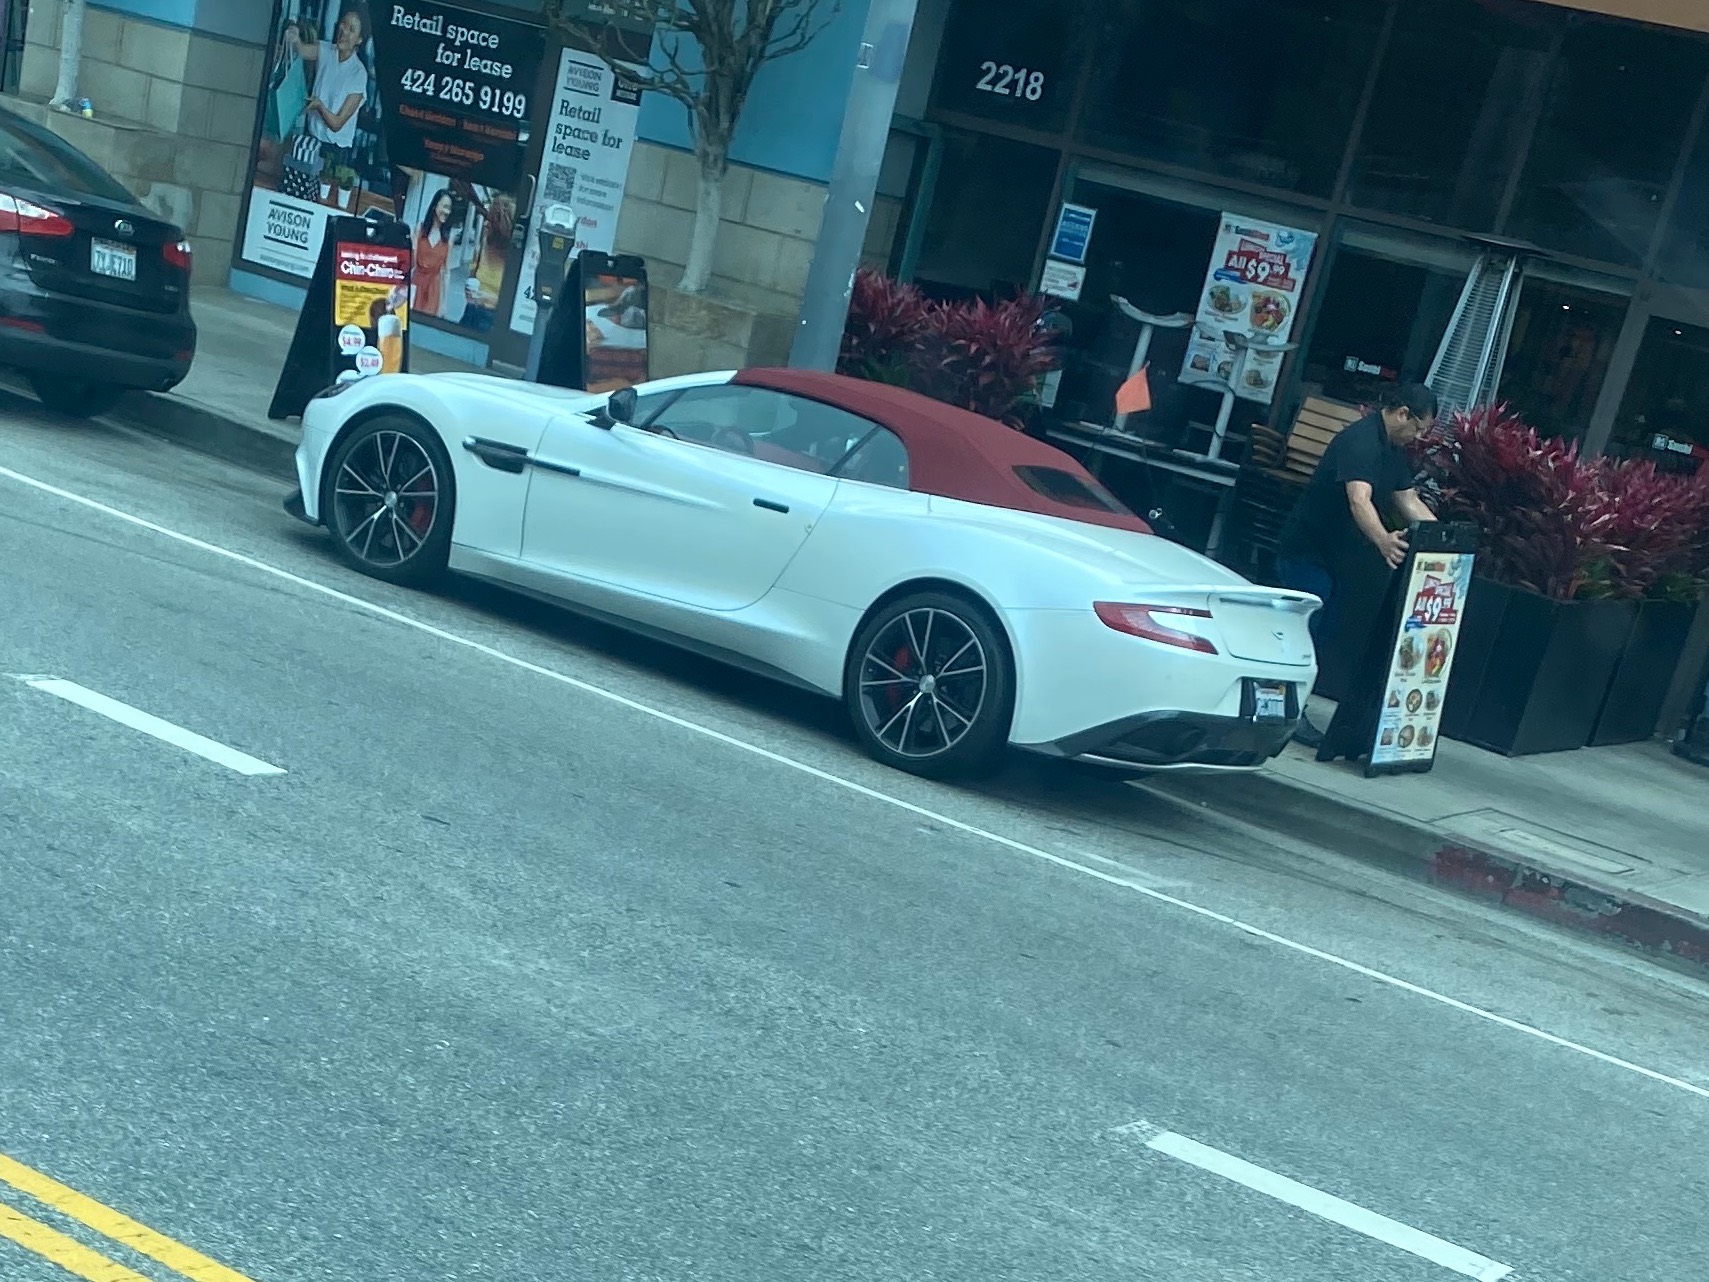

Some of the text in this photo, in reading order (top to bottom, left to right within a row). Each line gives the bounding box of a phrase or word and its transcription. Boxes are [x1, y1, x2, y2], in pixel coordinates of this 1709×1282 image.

[390, 5, 500, 49] Retail space
[435, 42, 513, 79] for lease
[401, 68, 436, 97] 424
[439, 76, 475, 106] 265
[479, 85, 527, 119] 9199
[976, 61, 1045, 101] 2218
[559, 99, 602, 124] Retail
[555, 122, 599, 143] space
[551, 136, 591, 161] lease
[267, 207, 312, 230] AVISON
[266, 221, 309, 244] YOUNG
